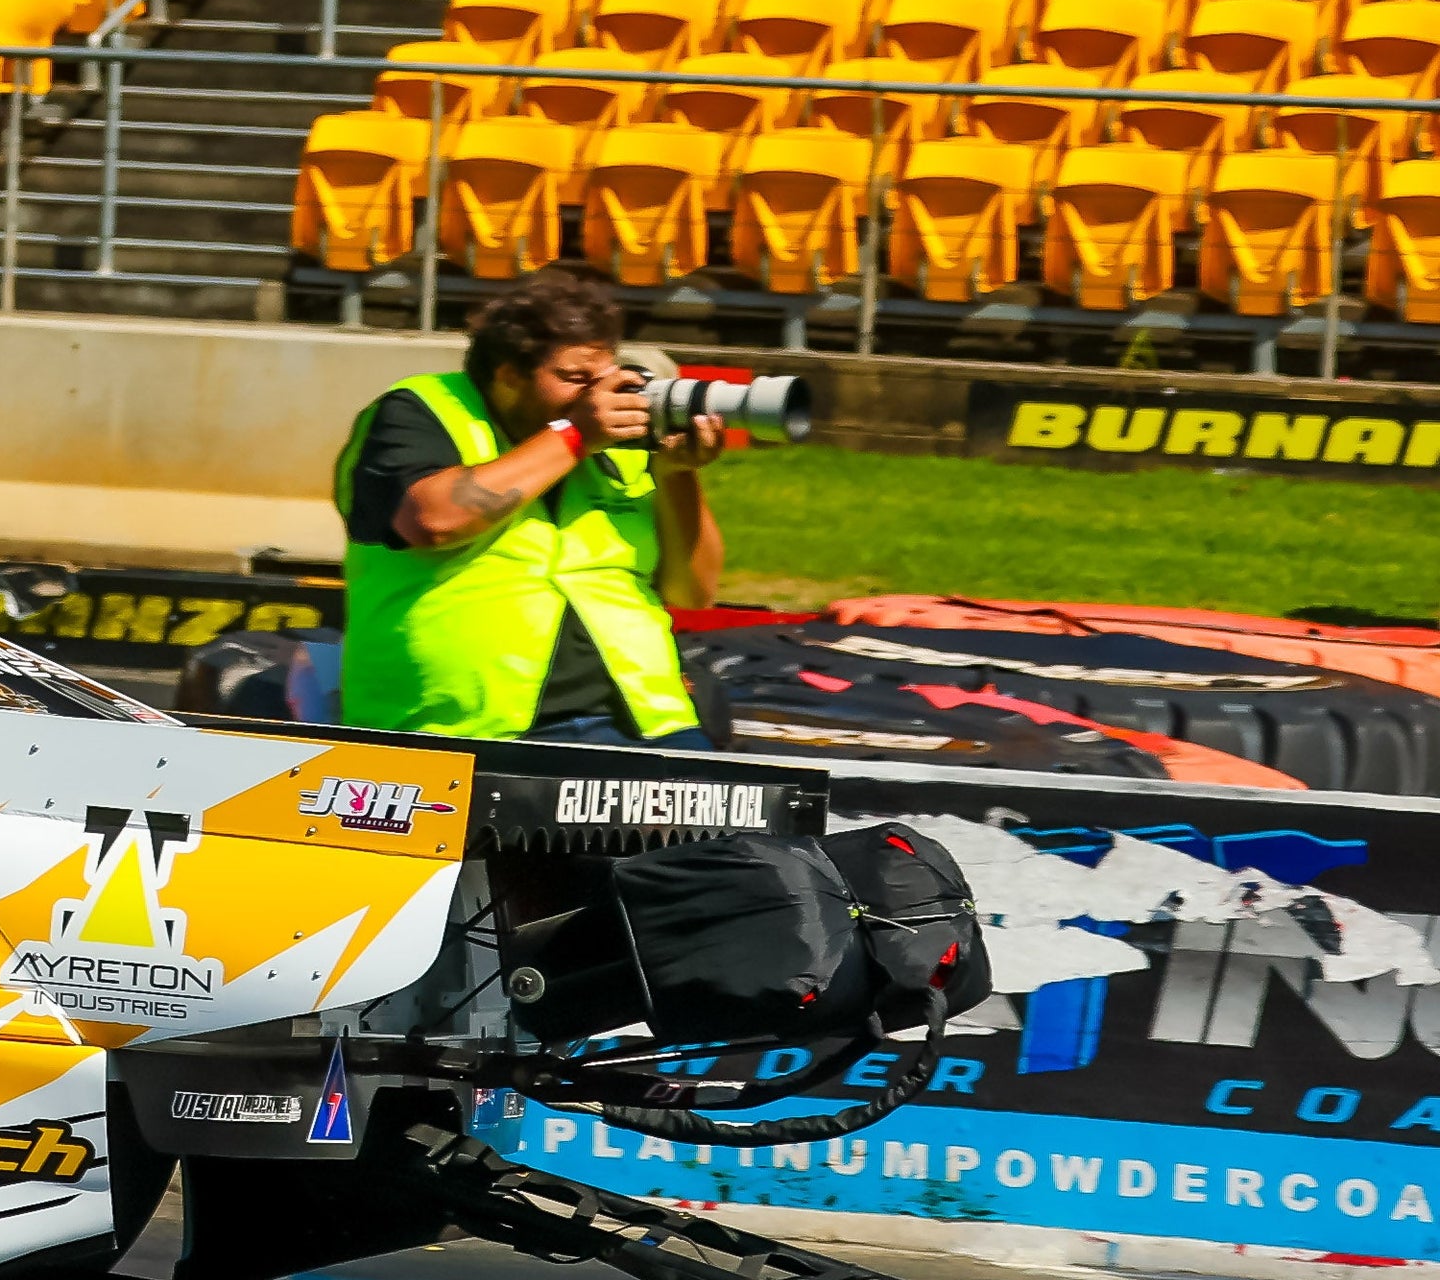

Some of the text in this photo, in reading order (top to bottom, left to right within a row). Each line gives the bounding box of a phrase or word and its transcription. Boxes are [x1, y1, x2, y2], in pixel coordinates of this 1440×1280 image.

[556, 779, 768, 829] GULF WESTERN OIL
[11, 952, 213, 995] AYRETON
[32, 988, 188, 1019] INDUSTRIES
